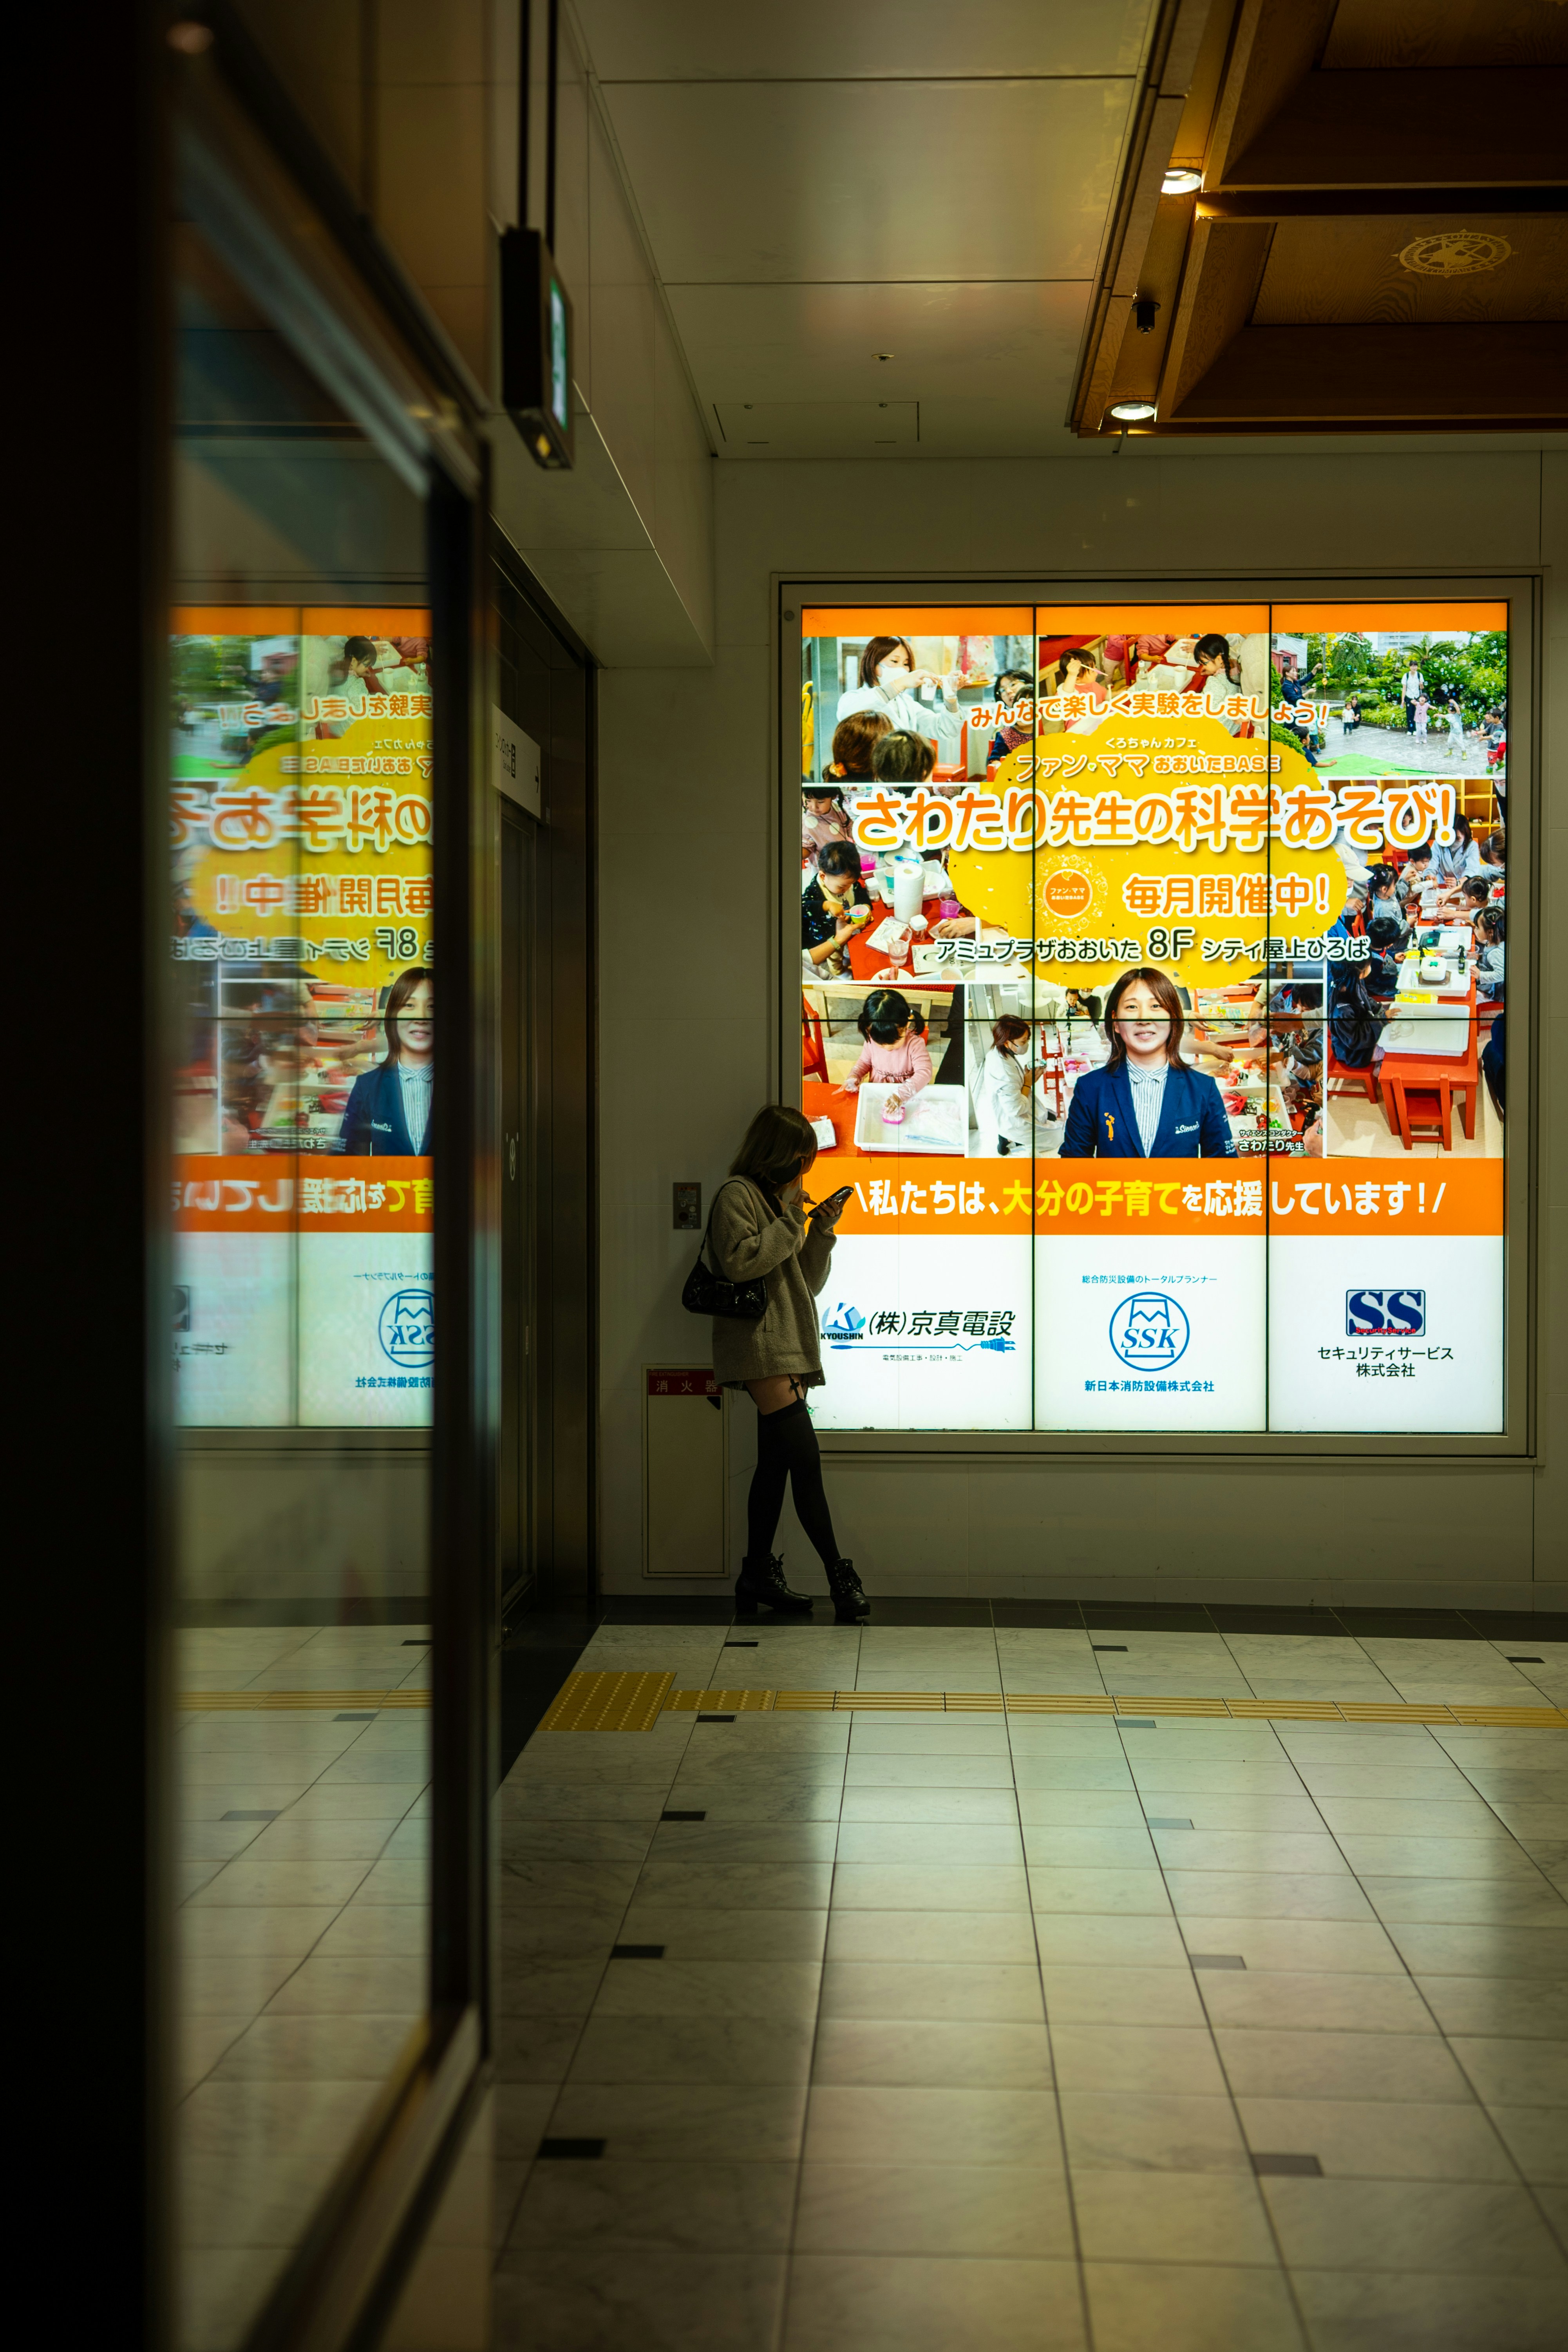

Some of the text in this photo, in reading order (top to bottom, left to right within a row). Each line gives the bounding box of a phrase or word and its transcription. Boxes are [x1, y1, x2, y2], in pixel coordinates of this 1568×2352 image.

[856, 787, 1454, 847] さわたり先生の科学あそび!
[1126, 876, 1327, 914] 毎月開催中!
[1148, 928, 1193, 958] 8F
[1203, 938, 1369, 961] シティ屋上ひろば
[1239, 1140, 1304, 1151] さわたり先生
[1082, 1275, 1217, 1284] 総合防災設備のトータルプランナー
[869, 1310, 1016, 1336] (株)京真電設
[1349, 1292, 1423, 1335] SS
[1121, 1328, 1180, 1348] SSK
[1318, 1346, 1454, 1361] セキュリティサービス
[1356, 1363, 1415, 1378] 株式会社
[1085, 1380, 1215, 1392] 新日本消防設備株式会社
